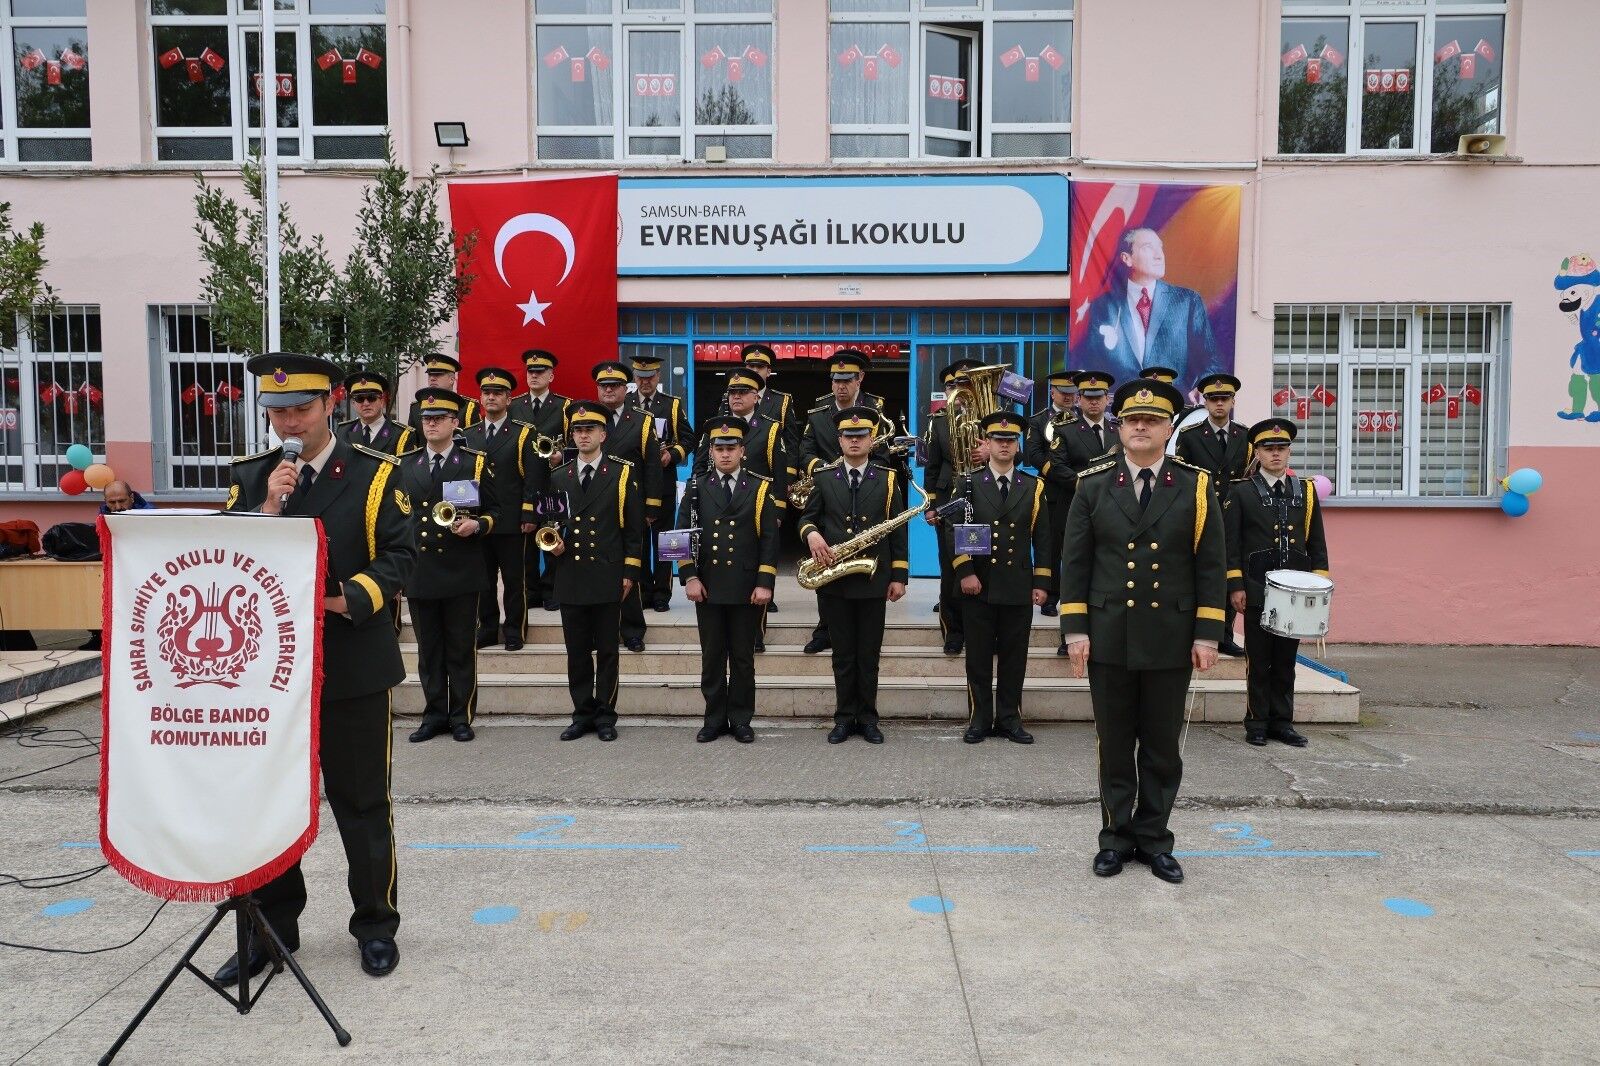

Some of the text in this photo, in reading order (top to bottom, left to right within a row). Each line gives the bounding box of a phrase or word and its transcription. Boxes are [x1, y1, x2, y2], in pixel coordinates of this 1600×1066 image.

[640, 205, 747, 218] SAMSUN-BAFRA
[640, 217, 966, 251] EVRENUŞAĞI İLKOKULU
[129, 548, 296, 693] SAHRA SIHHİYE OKULU VE EĞİTİM MERKEZİ
[150, 702, 270, 723] BÖLGE BANDO
[150, 726, 267, 746] KOMUTANLIĞI
